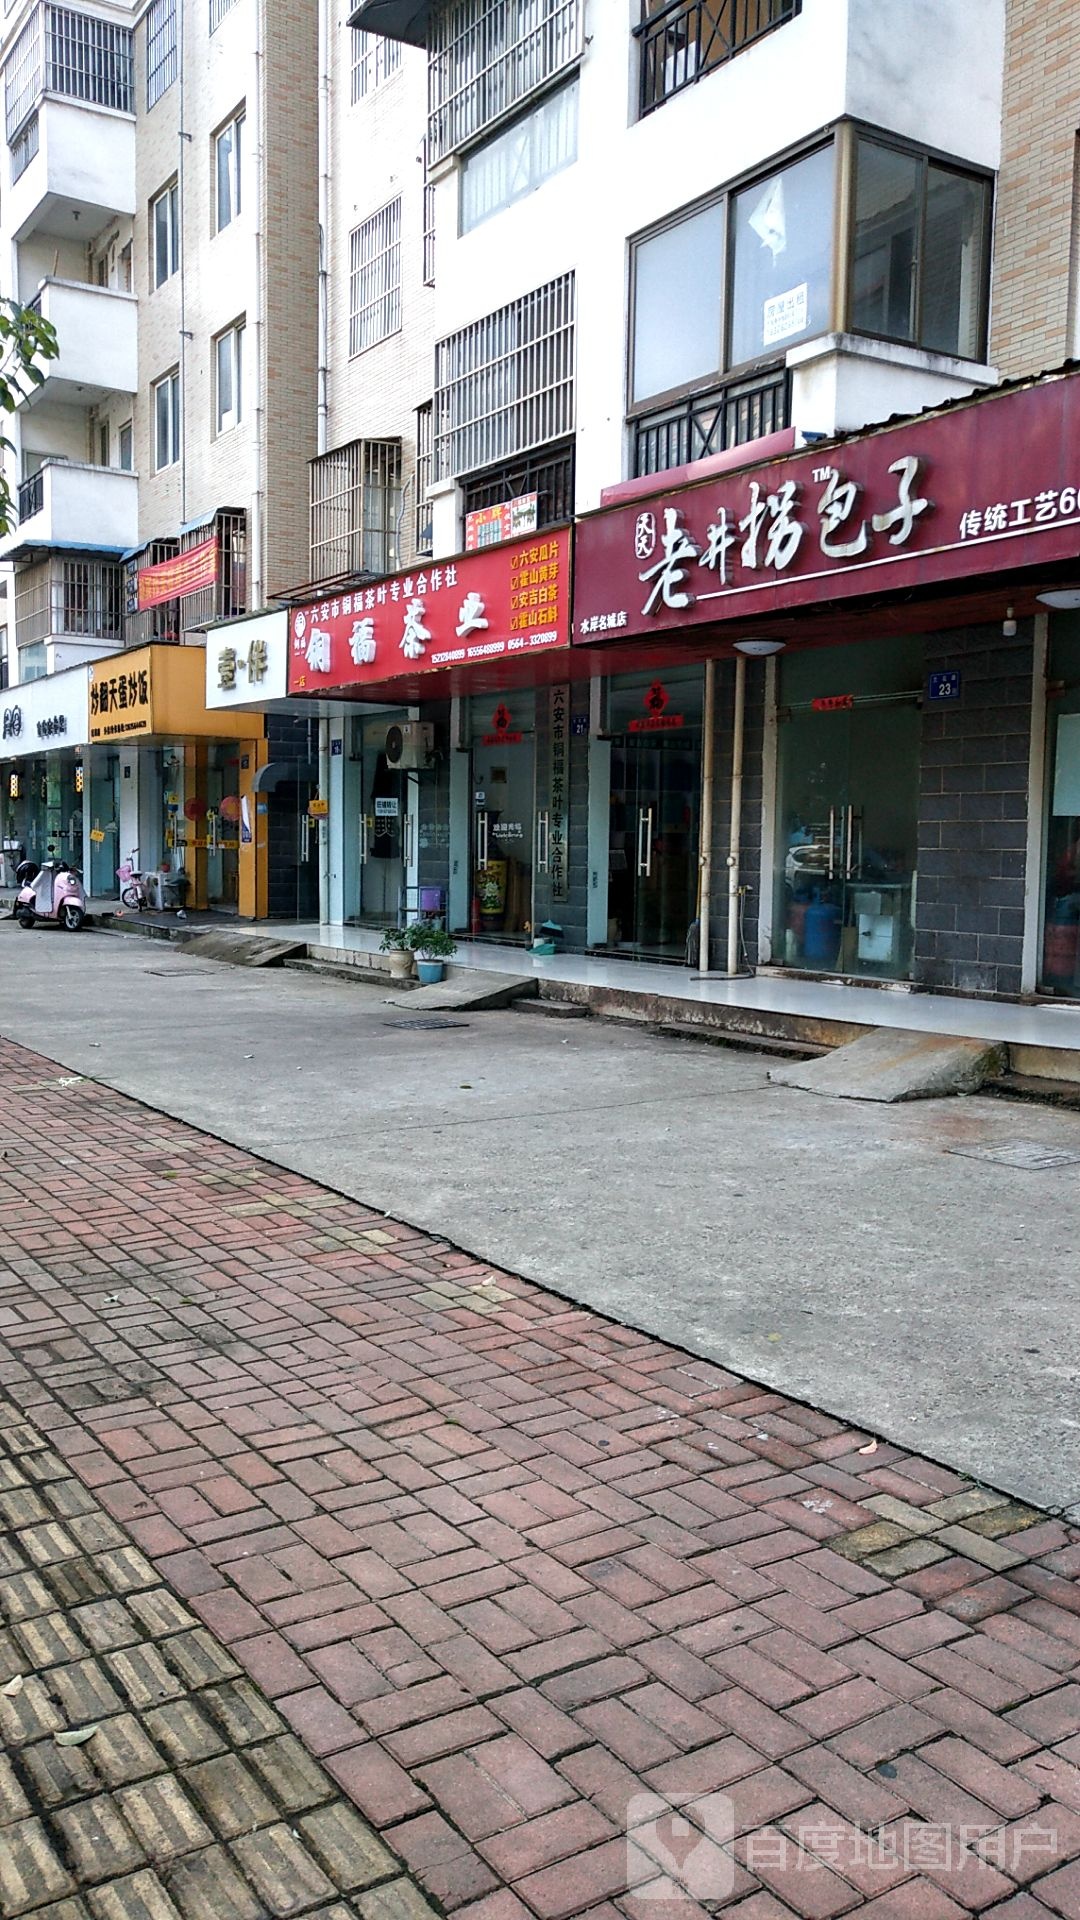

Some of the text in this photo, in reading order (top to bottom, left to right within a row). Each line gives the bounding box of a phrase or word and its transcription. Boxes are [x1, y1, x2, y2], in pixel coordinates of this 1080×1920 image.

[812, 466, 831, 483] TM
[637, 512, 653, 556] 天天
[959, 487, 1080, 540] 传统工艺6
[519, 540, 559, 567] 六安瓜片
[638, 455, 931, 617] 老井捞包子
[310, 564, 458, 624] 六安市铜福茶叶专业合作社
[518, 583, 558, 609] 安吉白茶
[519, 561, 559, 588] 霍山黄芽
[305, 591, 490, 674] 铜福茶业
[579, 610, 628, 635] 水岸名城店
[90, 669, 149, 716] 炒翻天蛋炒饭
[938, 683, 951, 696] 23
[551, 689, 566, 898] 六安市铜福茶叶专业合作社
